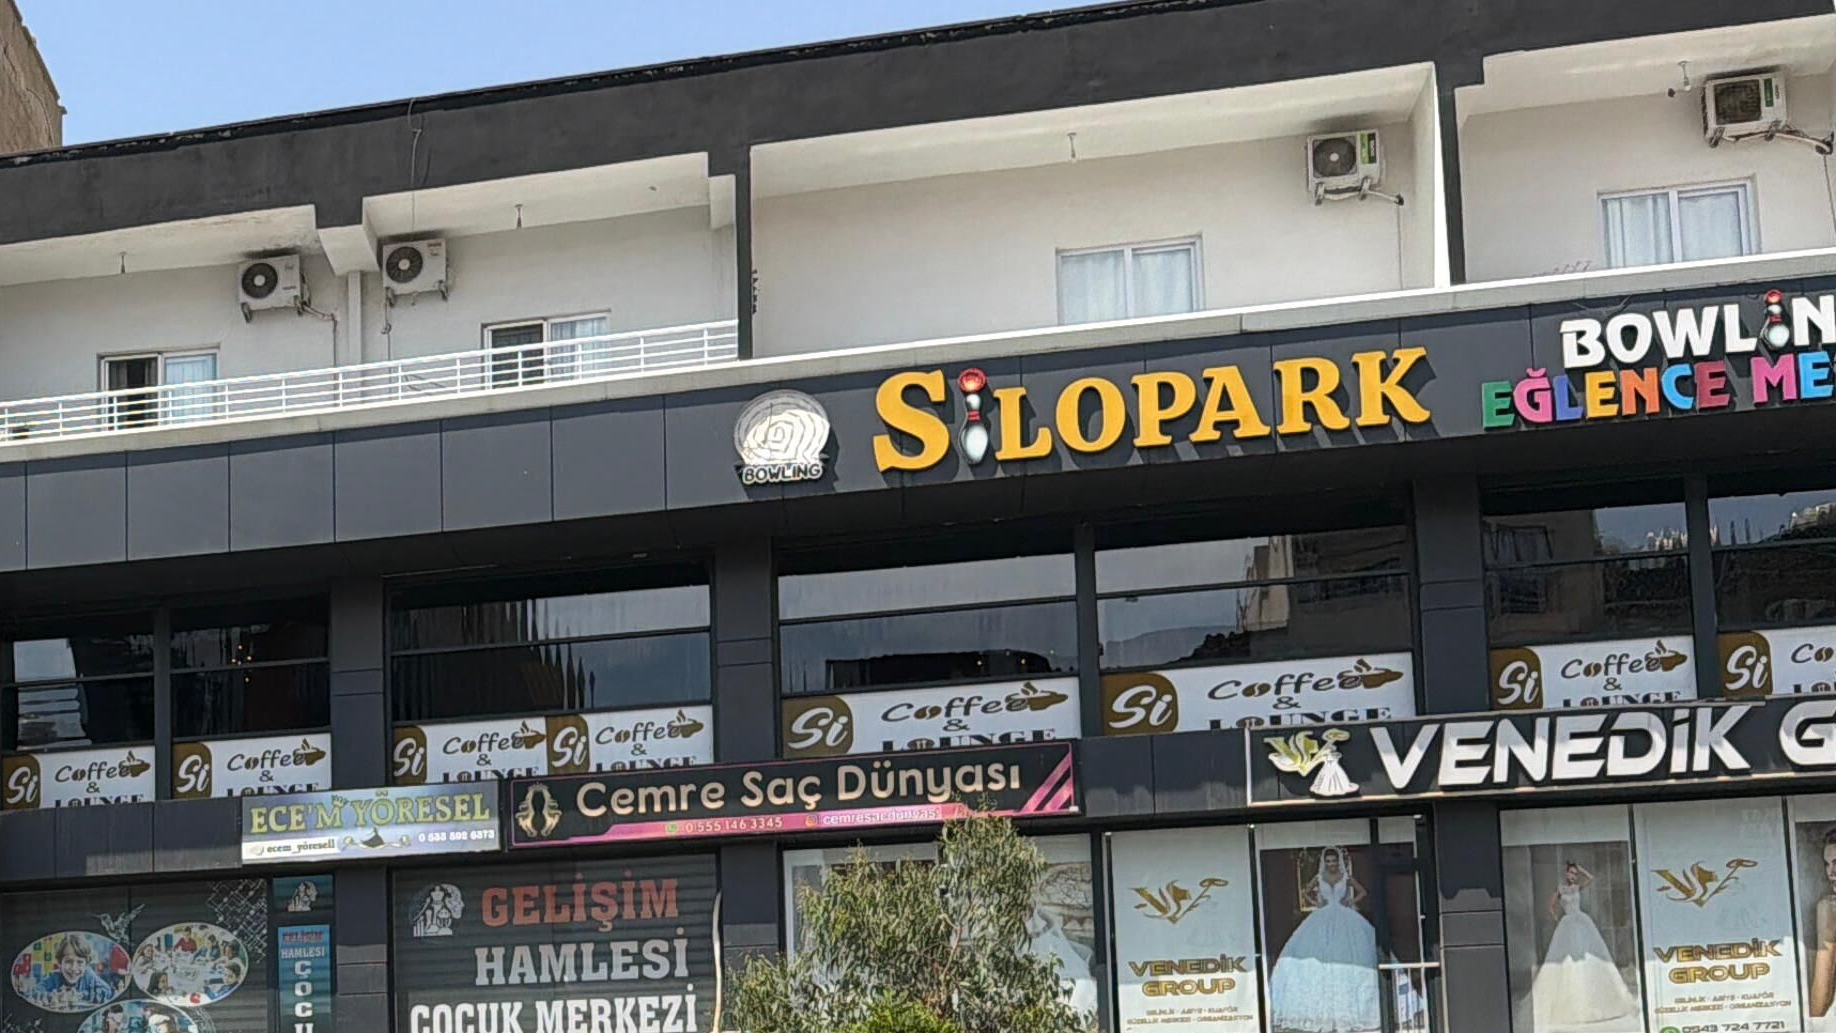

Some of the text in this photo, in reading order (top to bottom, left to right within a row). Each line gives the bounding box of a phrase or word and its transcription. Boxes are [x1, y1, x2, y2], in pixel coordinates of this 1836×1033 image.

[1481, 360, 1731, 430] EĞLENCE
[742, 460, 823, 484] BOWLING
[1603, 677, 1622, 690] &
[1272, 696, 1301, 709] &
[943, 718, 969, 731] &
[631, 744, 648, 756] &
[1369, 703, 1752, 789] VENEDİK
[476, 754, 492, 766] &
[259, 770, 274, 782] &
[86, 782, 100, 793] &
[576, 760, 1020, 818] Cemre Saç Dünyası
[345, 791, 490, 827] YÖRESEL
[481, 869, 679, 932] GELİŞİM
[475, 927, 689, 986] HAMLESİ
[1653, 937, 1783, 963] VENEDİK
[1128, 953, 1247, 976] VENEDİK
[1668, 962, 1770, 984] GROUP
[1142, 977, 1236, 997] GROUP
